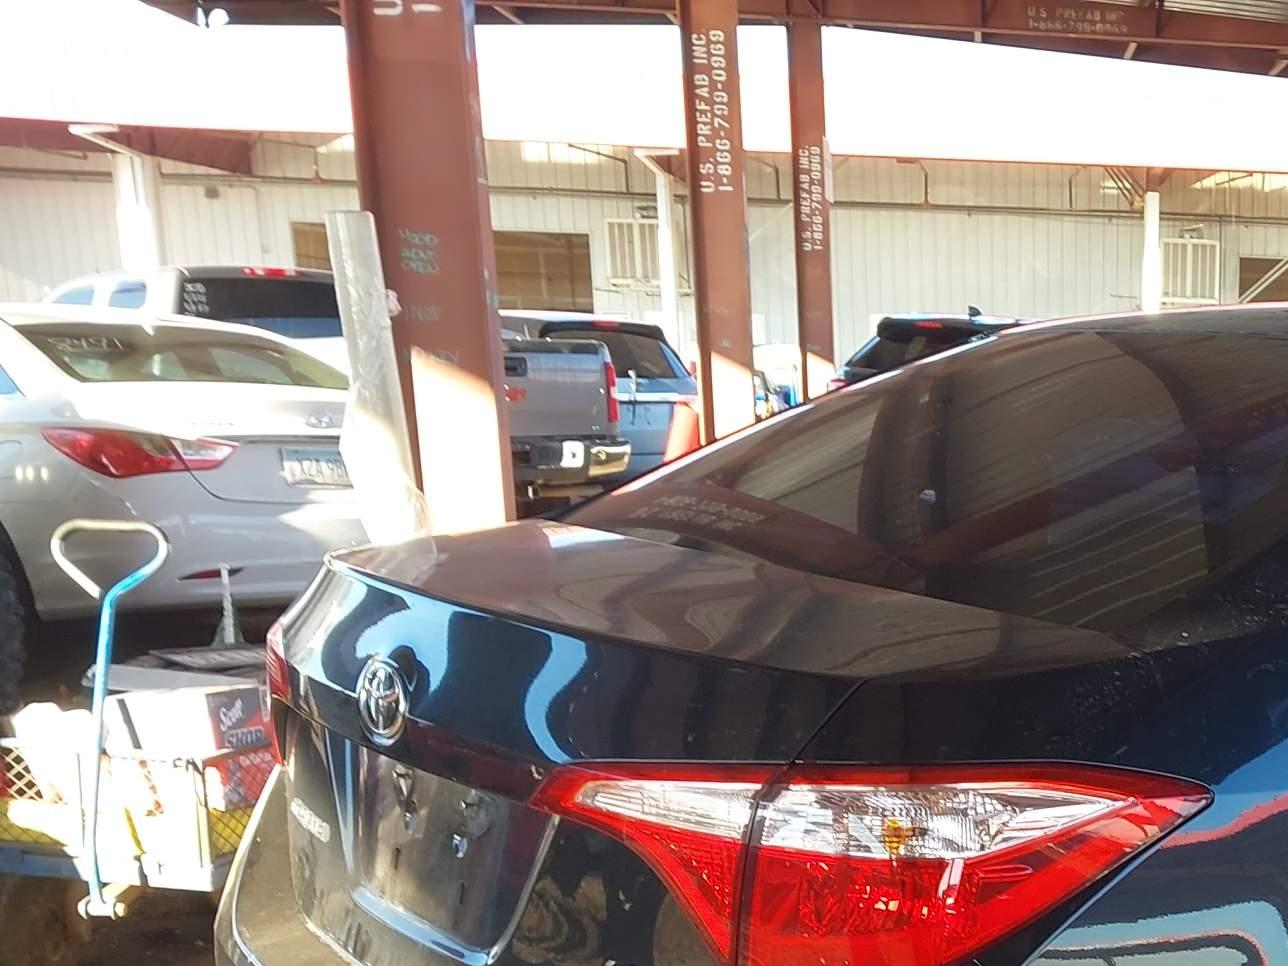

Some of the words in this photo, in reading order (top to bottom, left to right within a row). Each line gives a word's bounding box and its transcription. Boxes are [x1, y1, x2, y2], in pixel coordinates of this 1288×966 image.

[694, 73, 713, 148] PREFAB
[708, 29, 734, 192] 1-866-799-0969
[799, 174, 811, 222] PREFAB
